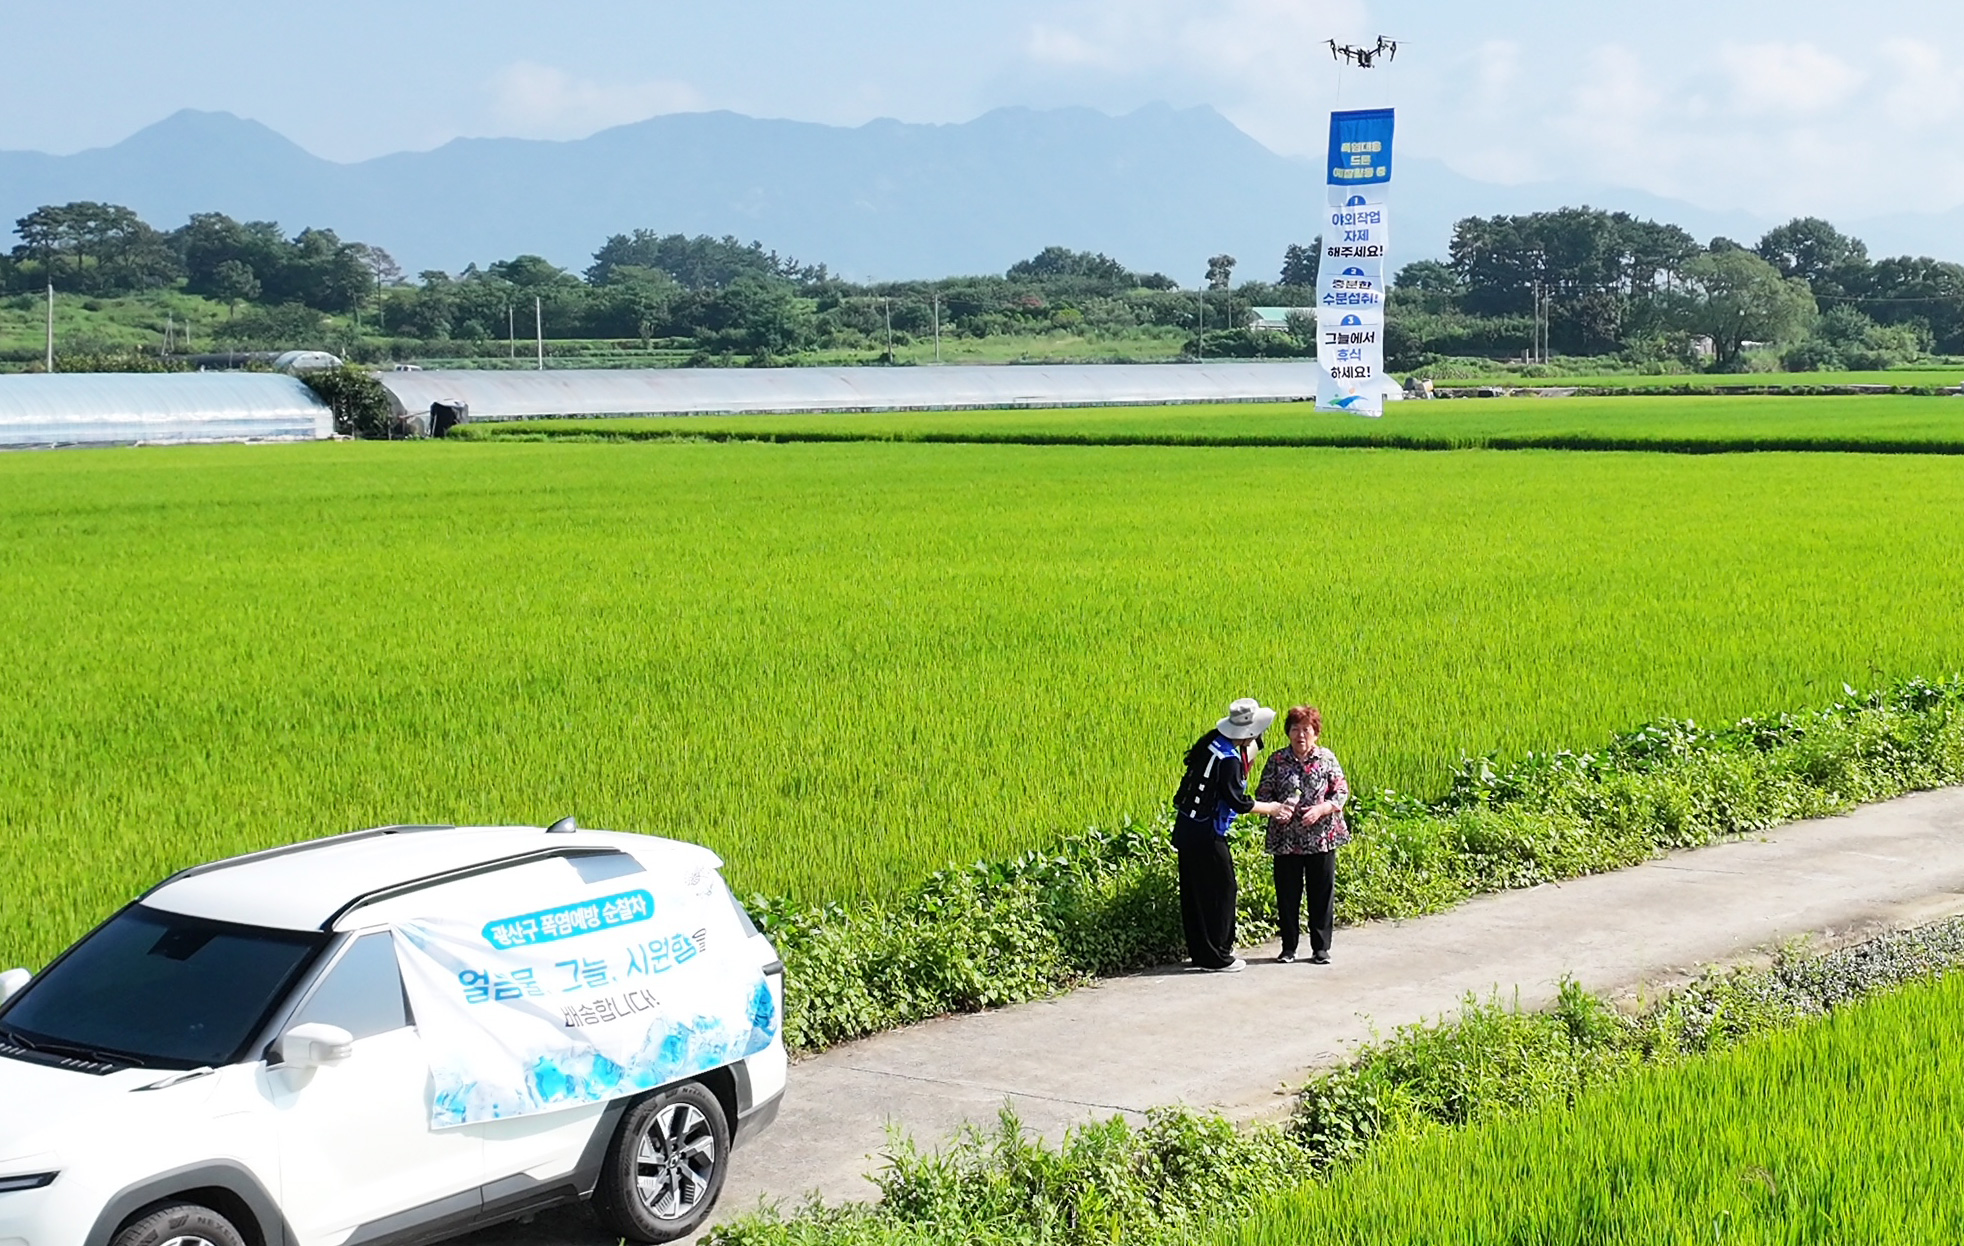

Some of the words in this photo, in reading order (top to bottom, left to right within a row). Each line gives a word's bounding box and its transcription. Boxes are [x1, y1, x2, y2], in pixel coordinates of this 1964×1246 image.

[1332, 211, 1381, 225] 야외작업
[1344, 229, 1369, 242] 자제
[1328, 246, 1383, 258] 해주세요!
[1323, 292, 1378, 305] 수분섭취!
[1325, 332, 1375, 345] 그늘에서
[1337, 348, 1362, 361] 휴식
[1331, 366, 1371, 379] 하세요!
[490, 919, 538, 945] 광산구
[540, 904, 601, 937] 폭염예방
[602, 894, 647, 923] 순찰차
[560, 989, 661, 1028] 배송합니다!
